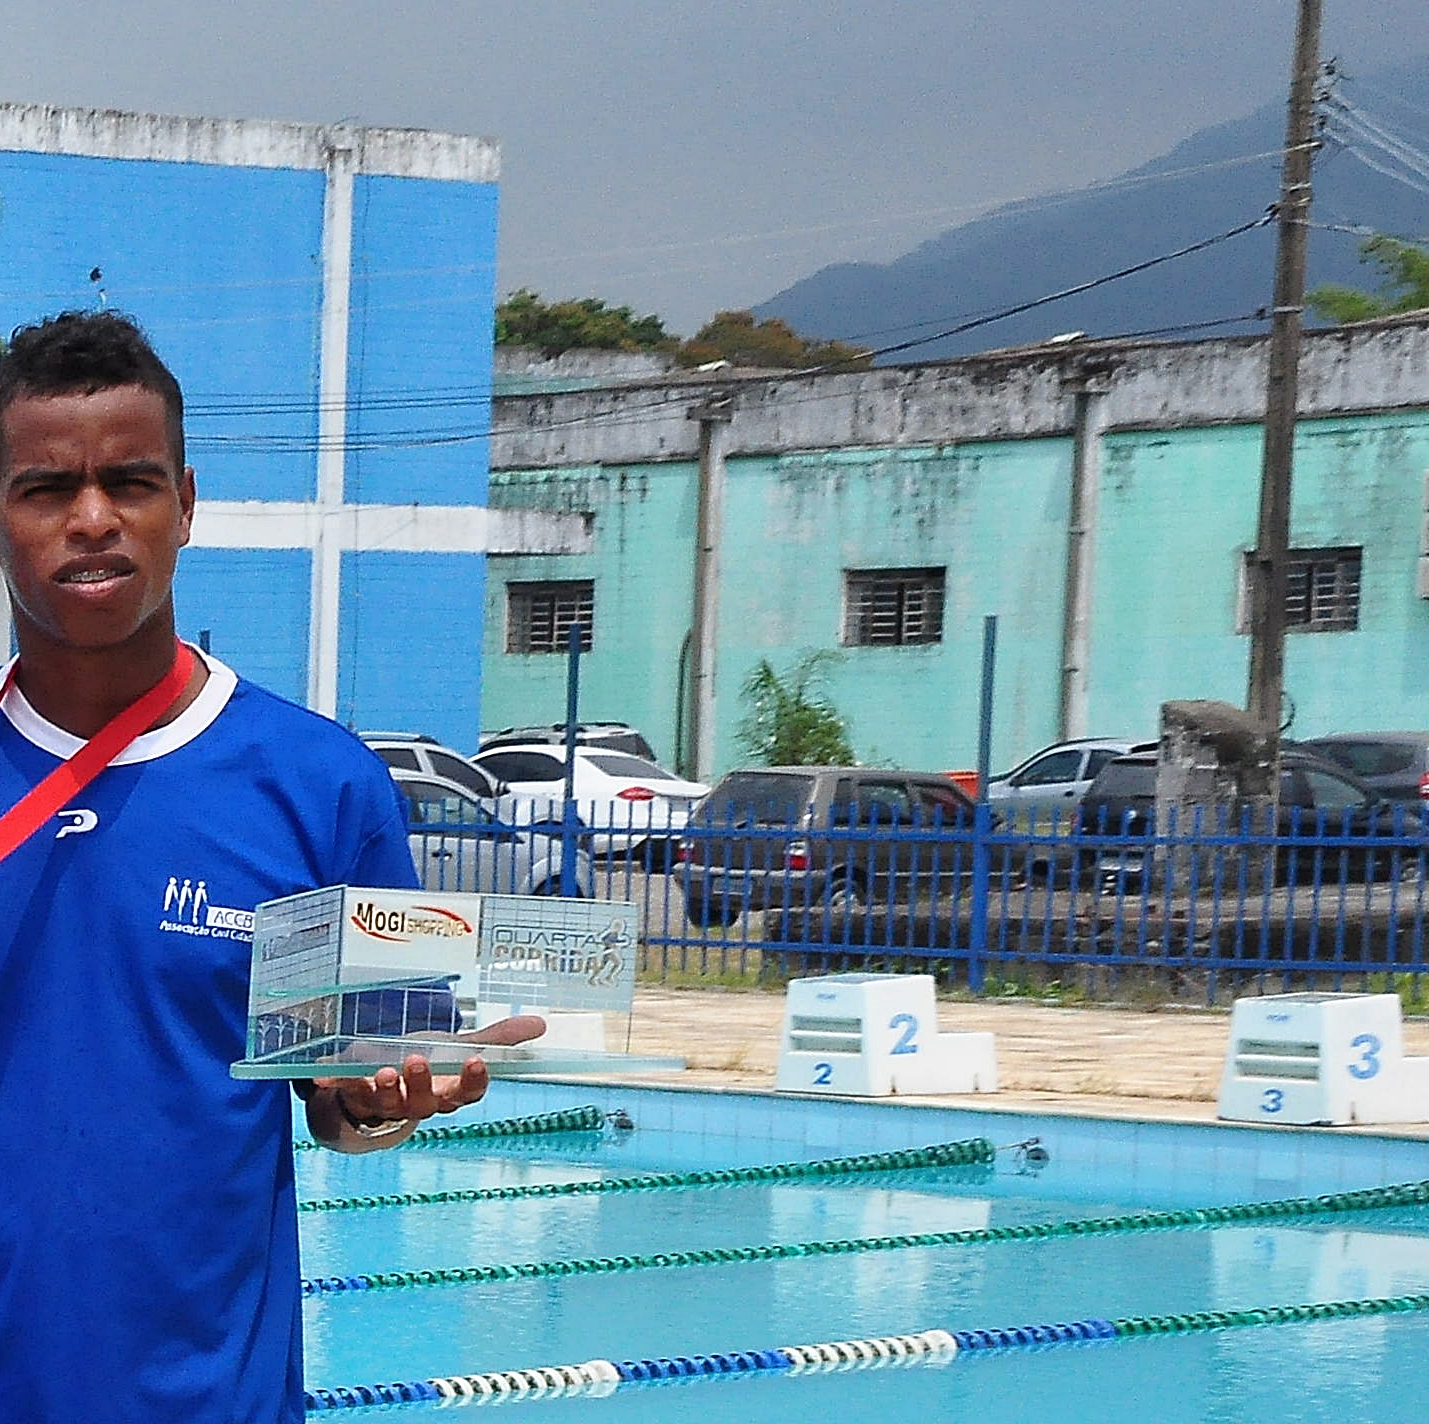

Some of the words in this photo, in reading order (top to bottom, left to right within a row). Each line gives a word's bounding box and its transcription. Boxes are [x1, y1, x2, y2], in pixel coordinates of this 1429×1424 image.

[889, 1013, 918, 1055] 2
[1348, 1034, 1381, 1080] 3
[813, 1063, 833, 1085] 2
[1261, 1089, 1284, 1113] 3
